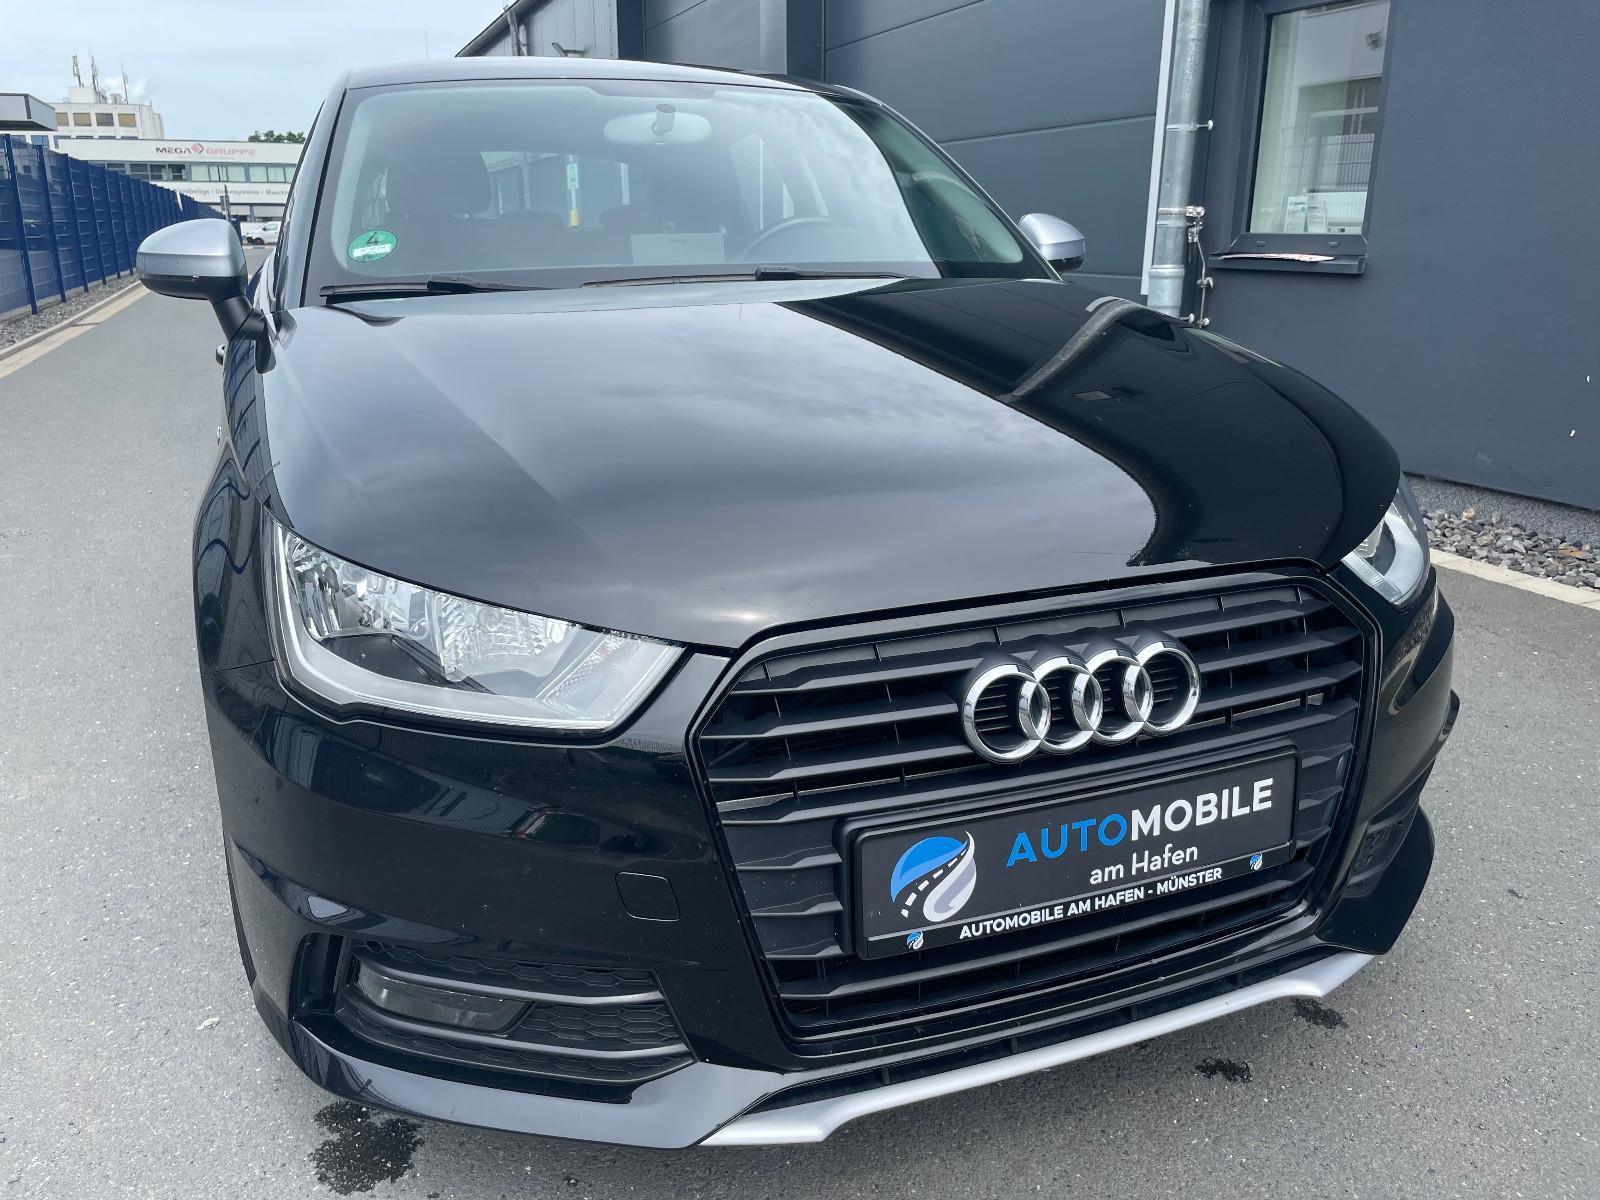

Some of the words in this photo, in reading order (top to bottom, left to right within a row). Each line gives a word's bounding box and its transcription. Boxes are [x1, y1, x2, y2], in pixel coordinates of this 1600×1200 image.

[155, 146, 192, 155] MEGA
[205, 147, 256, 156] GRUPPE
[366, 231, 380, 245] 4
[1006, 777, 1274, 868] AUTOMOBILE
[1089, 864, 1124, 885] am
[1131, 843, 1198, 876] Hafen
[959, 904, 1064, 940] AUTOMOBILE
[1067, 899, 1091, 917] AM
[1094, 886, 1144, 911] HAFEN
[1156, 867, 1222, 895] MÜNSTER
